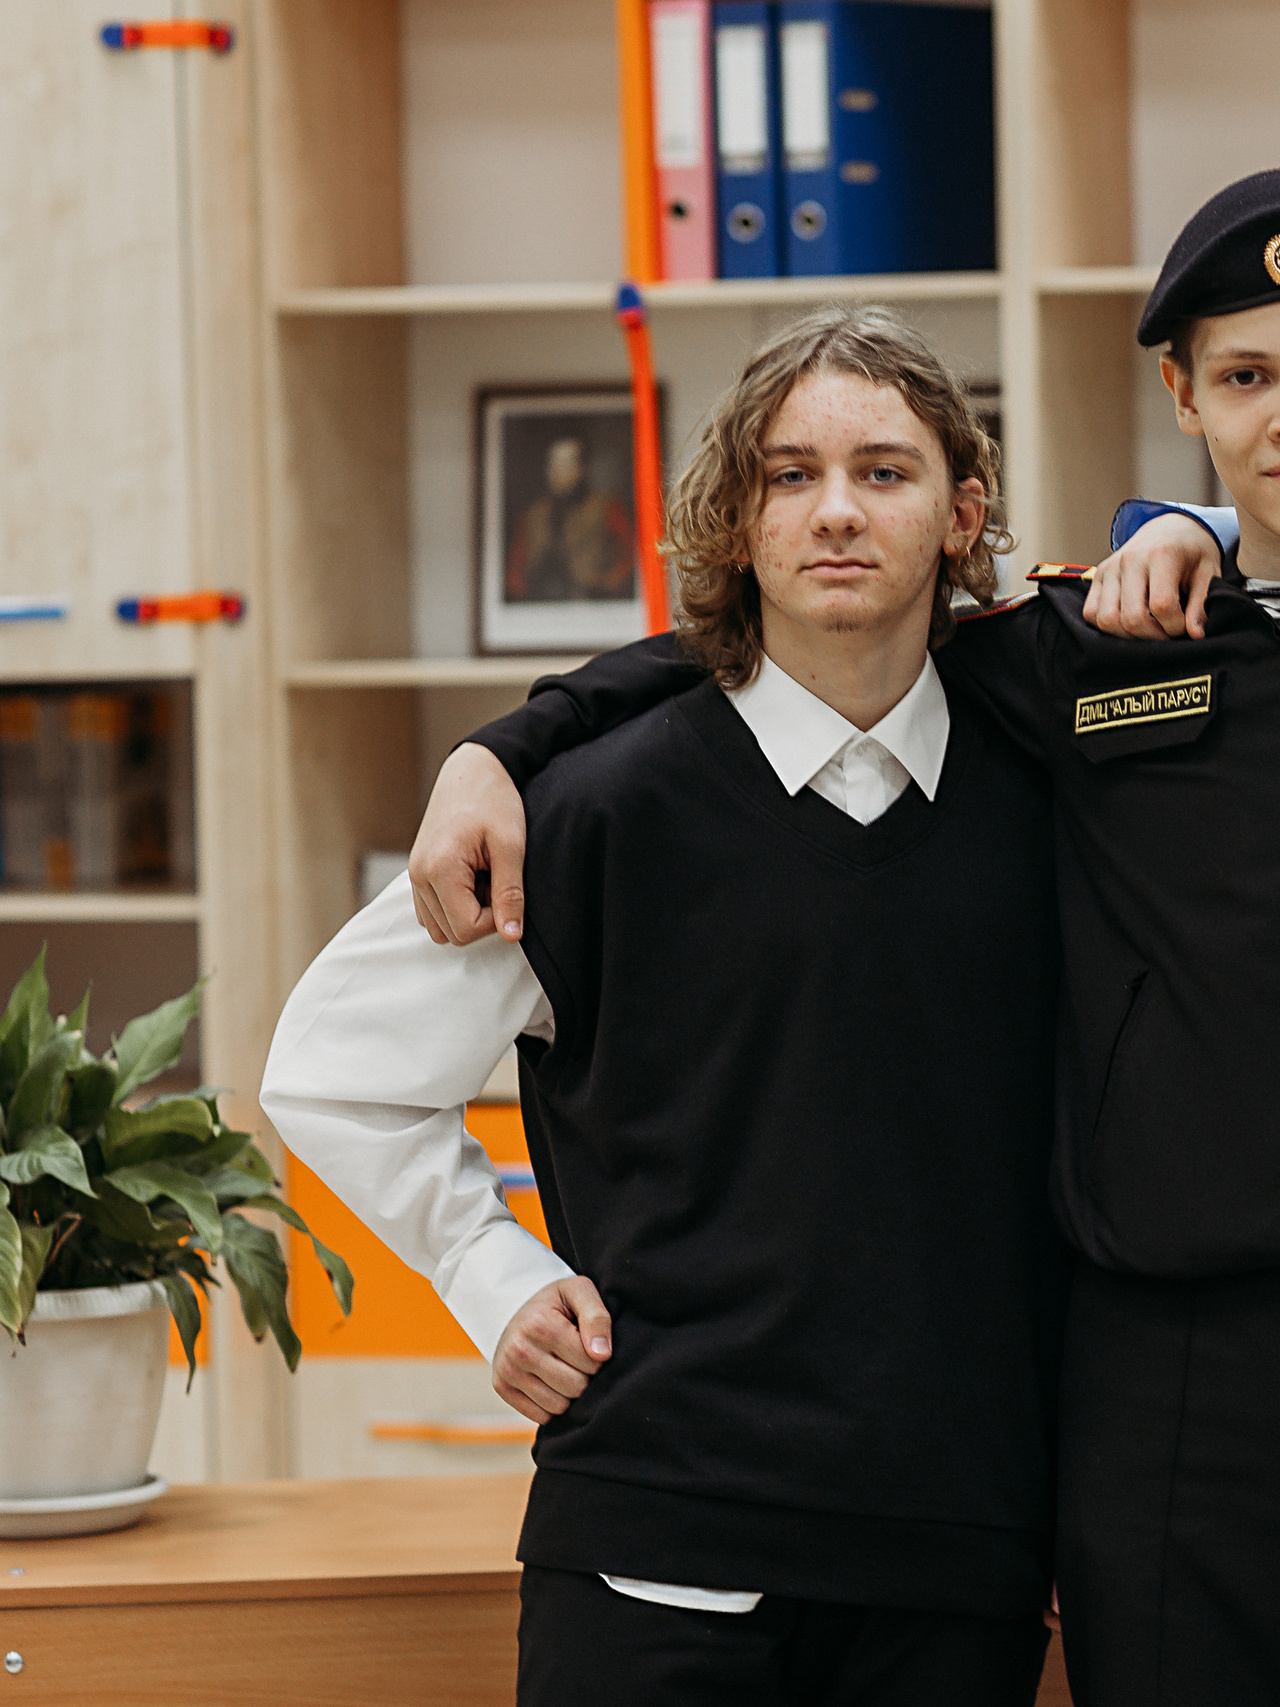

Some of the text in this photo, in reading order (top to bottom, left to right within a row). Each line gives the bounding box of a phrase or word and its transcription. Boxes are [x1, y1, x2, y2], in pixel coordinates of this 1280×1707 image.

[1079, 685, 1207, 726] ДМЦ "АЛЫЙ ПАРУС"
